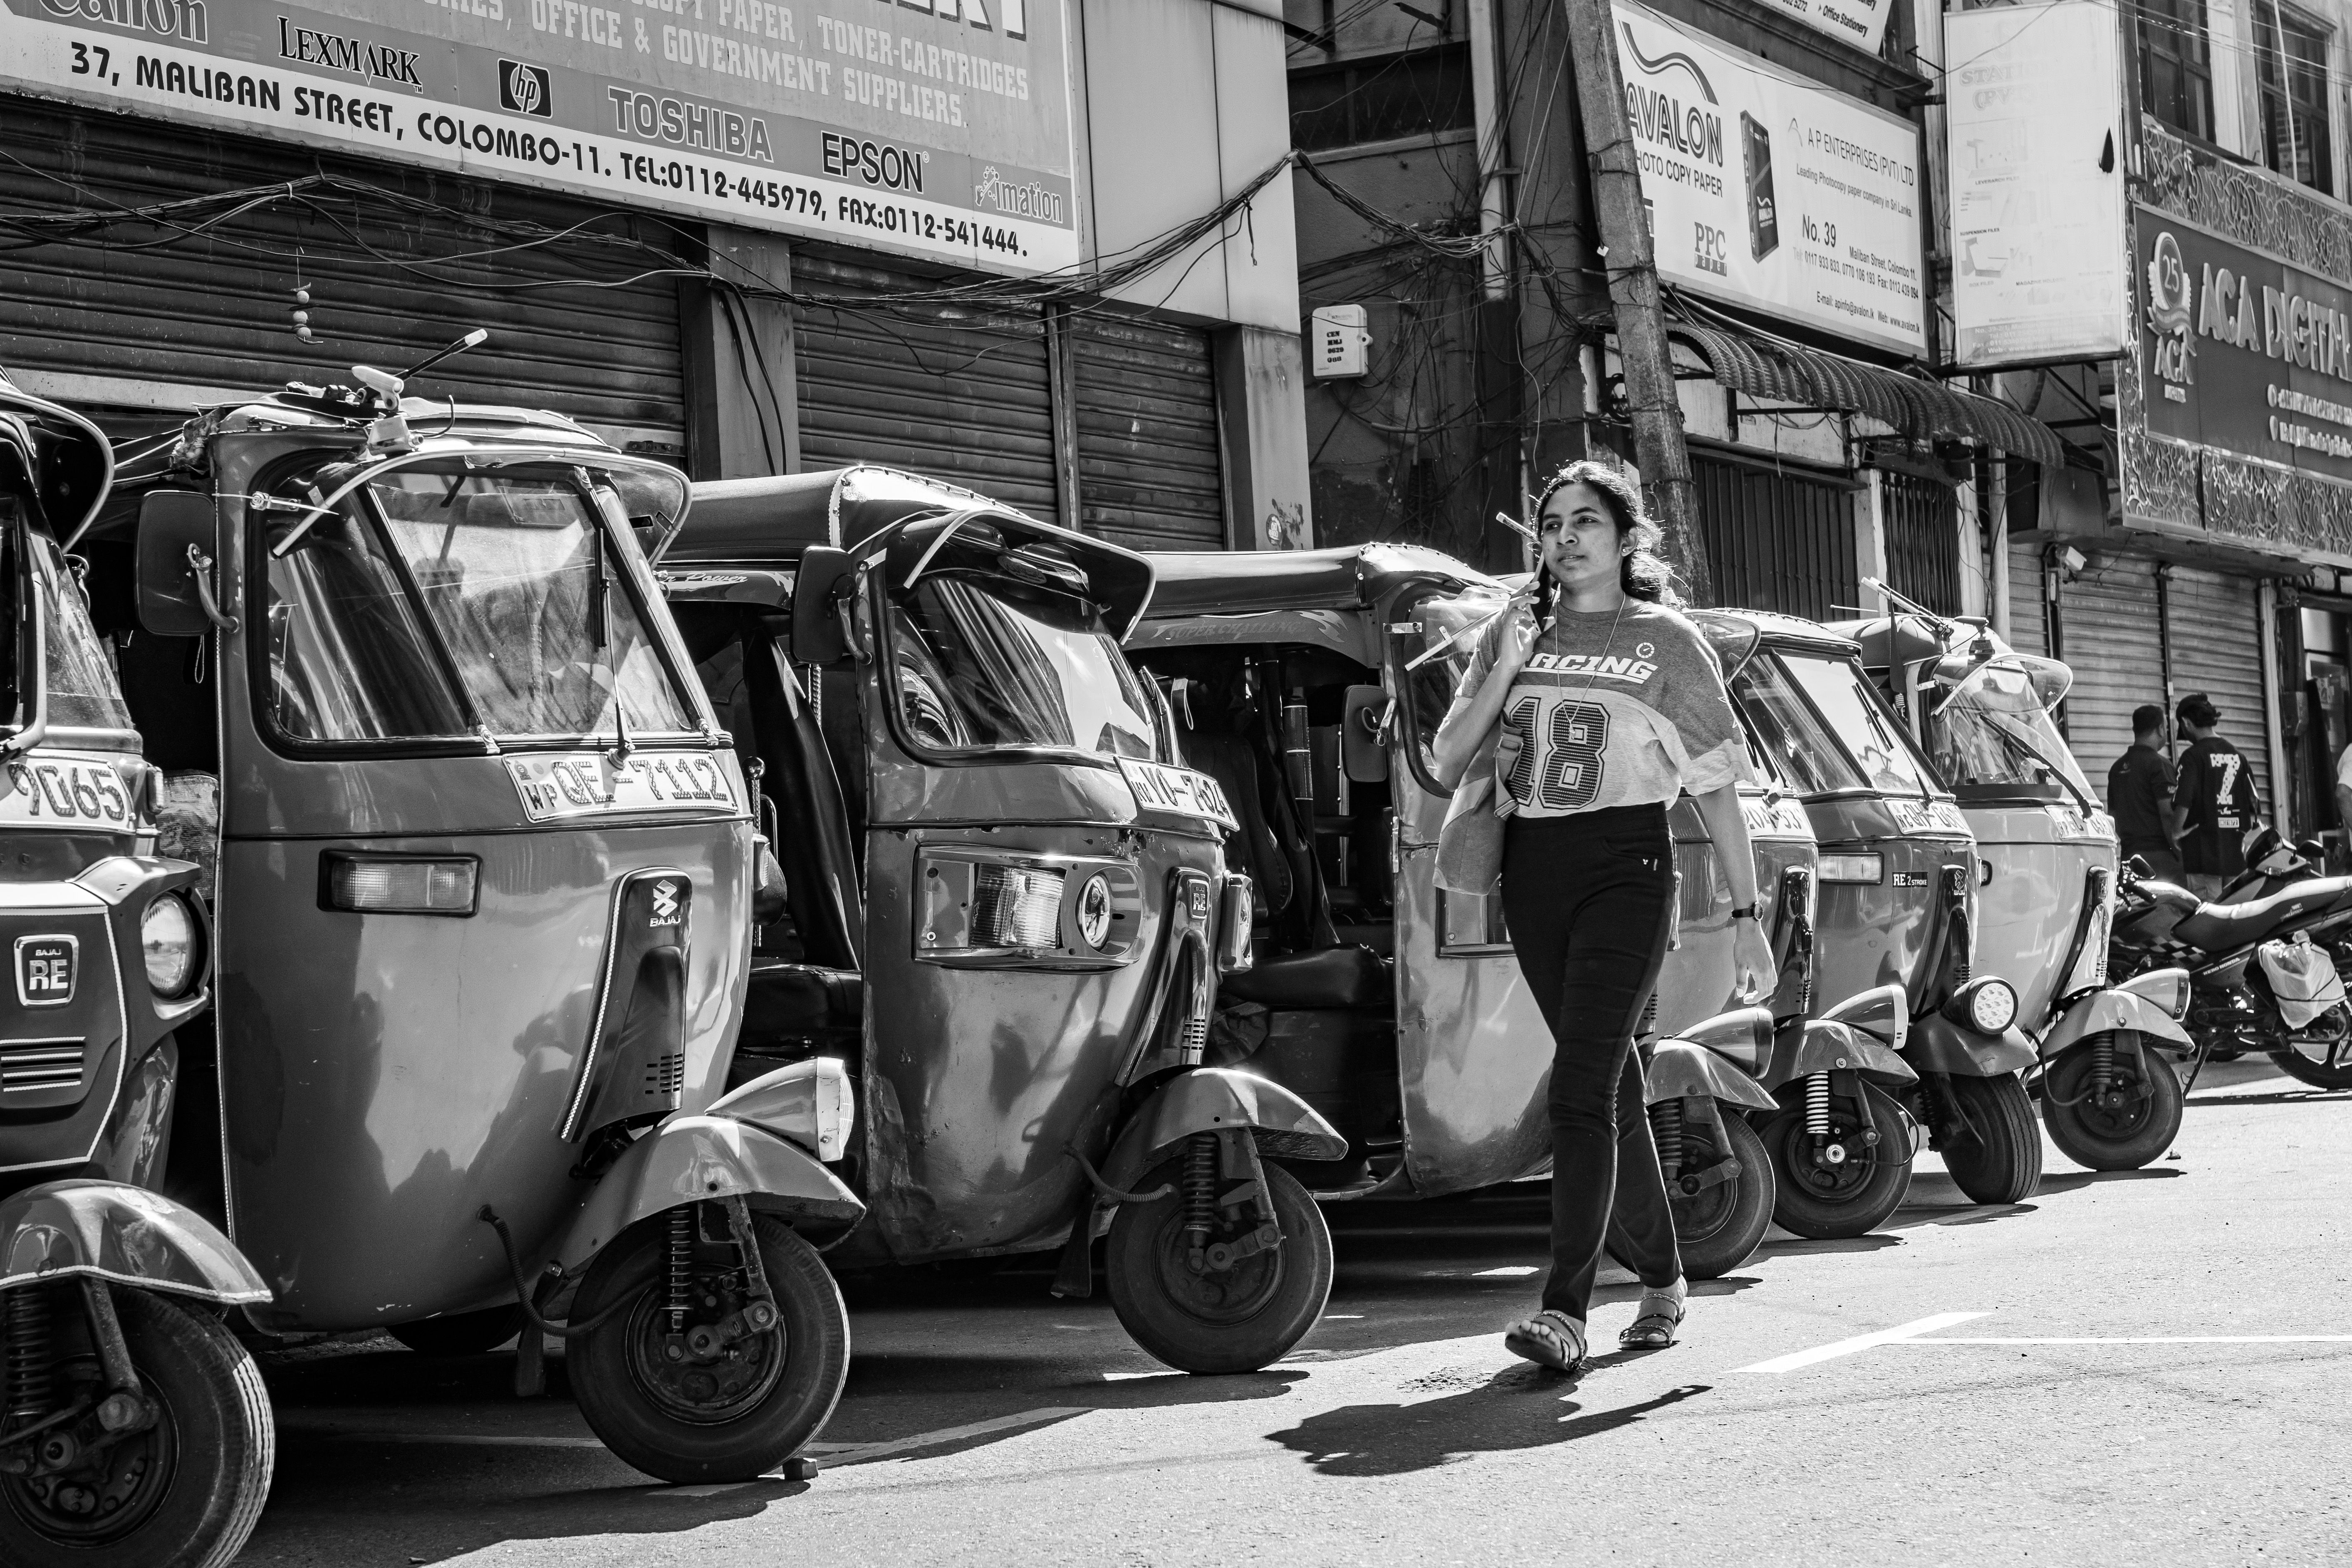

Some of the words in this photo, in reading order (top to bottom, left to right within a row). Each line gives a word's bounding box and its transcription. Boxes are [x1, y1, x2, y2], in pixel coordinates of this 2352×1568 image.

[1823, 5, 1840, 22] Office
[1840, 12, 1868, 37] Stationery
[277, 15, 422, 86] LEXMARK
[531, 0, 623, 49] OFFICE
[634, 17, 651, 54] &
[663, 25, 831, 96] GOVERNMENT
[843, 67, 968, 128] SUPPLIERS.
[718, 0, 804, 50] PAPER,
[817, 15, 1029, 101] TONER-CARTRIDGES
[608, 85, 774, 163] TOSHIBA
[1626, 82, 1723, 168] AVALON
[71, 41, 120, 87] 37,
[136, 55, 280, 112] MALIBAN
[294, 86, 404, 141] STREET,
[417, 112, 611, 177] COLOMBO-11.
[620, 151, 827, 221] TEL:0112-445979,
[839, 196, 1027, 257] FAX:0112-541444.
[820, 130, 924, 195] EPSON
[1808, 127, 1814, 148] A
[1816, 129, 1821, 150] P
[1824, 133, 1878, 172] ENTERPRISES
[1880, 156, 1899, 183] (PVT)
[1901, 164, 1914, 187] LTD
[1635, 149, 1664, 176] HOTO
[1666, 159, 1691, 186] COPY
[1694, 169, 1723, 198] PAPER
[1796, 163, 1818, 185] Leading
[1819, 171, 1847, 195] Photocopy
[1847, 184, 1862, 200] paper
[1863, 188, 1884, 209] company
[1885, 196, 1890, 208] in
[995, 178, 1063, 224] imation
[1694, 221, 1726, 261] PPC
[1802, 213, 1820, 243] No.
[1824, 222, 1836, 248] 39
[1694, 254, 1727, 276] paper
[1805, 250, 1817, 266] 0117
[1819, 255, 1829, 270] 933
[1842, 264, 1854, 279] 0770
[1856, 268, 1865, 282] 106
[1867, 271, 1875, 285] 193
[1878, 275, 1889, 290] Fax:
[1889, 278, 1901, 294] 0112
[1849, 245, 1870, 264] Maliban
[1871, 253, 1887, 272] Street,
[1888, 259, 1909, 278] Colombo
[2163, 255, 2180, 293] 25
[1817, 291, 1833, 307] E-mail:
[1835, 298, 1874, 320] apinfo@avalon.lk
[1877, 310, 1889, 324] Web:
[1890, 315, 1920, 334] www.avalon.lk
[2199, 263, 2260, 352] ACA
[685, 572, 748, 582] Power
[1526, 652, 1659, 681] ACING
[1508, 696, 1611, 810] 18
[522, 783, 558, 810] WP
[2210, 753, 2241, 805] 7
[1193, 893, 1206, 911] RE
[1907, 876, 1911, 886] 2
[650, 915, 681, 927] BAJAJ
[29, 959, 69, 990] RE
[2219, 957, 2240, 969] HONDA
